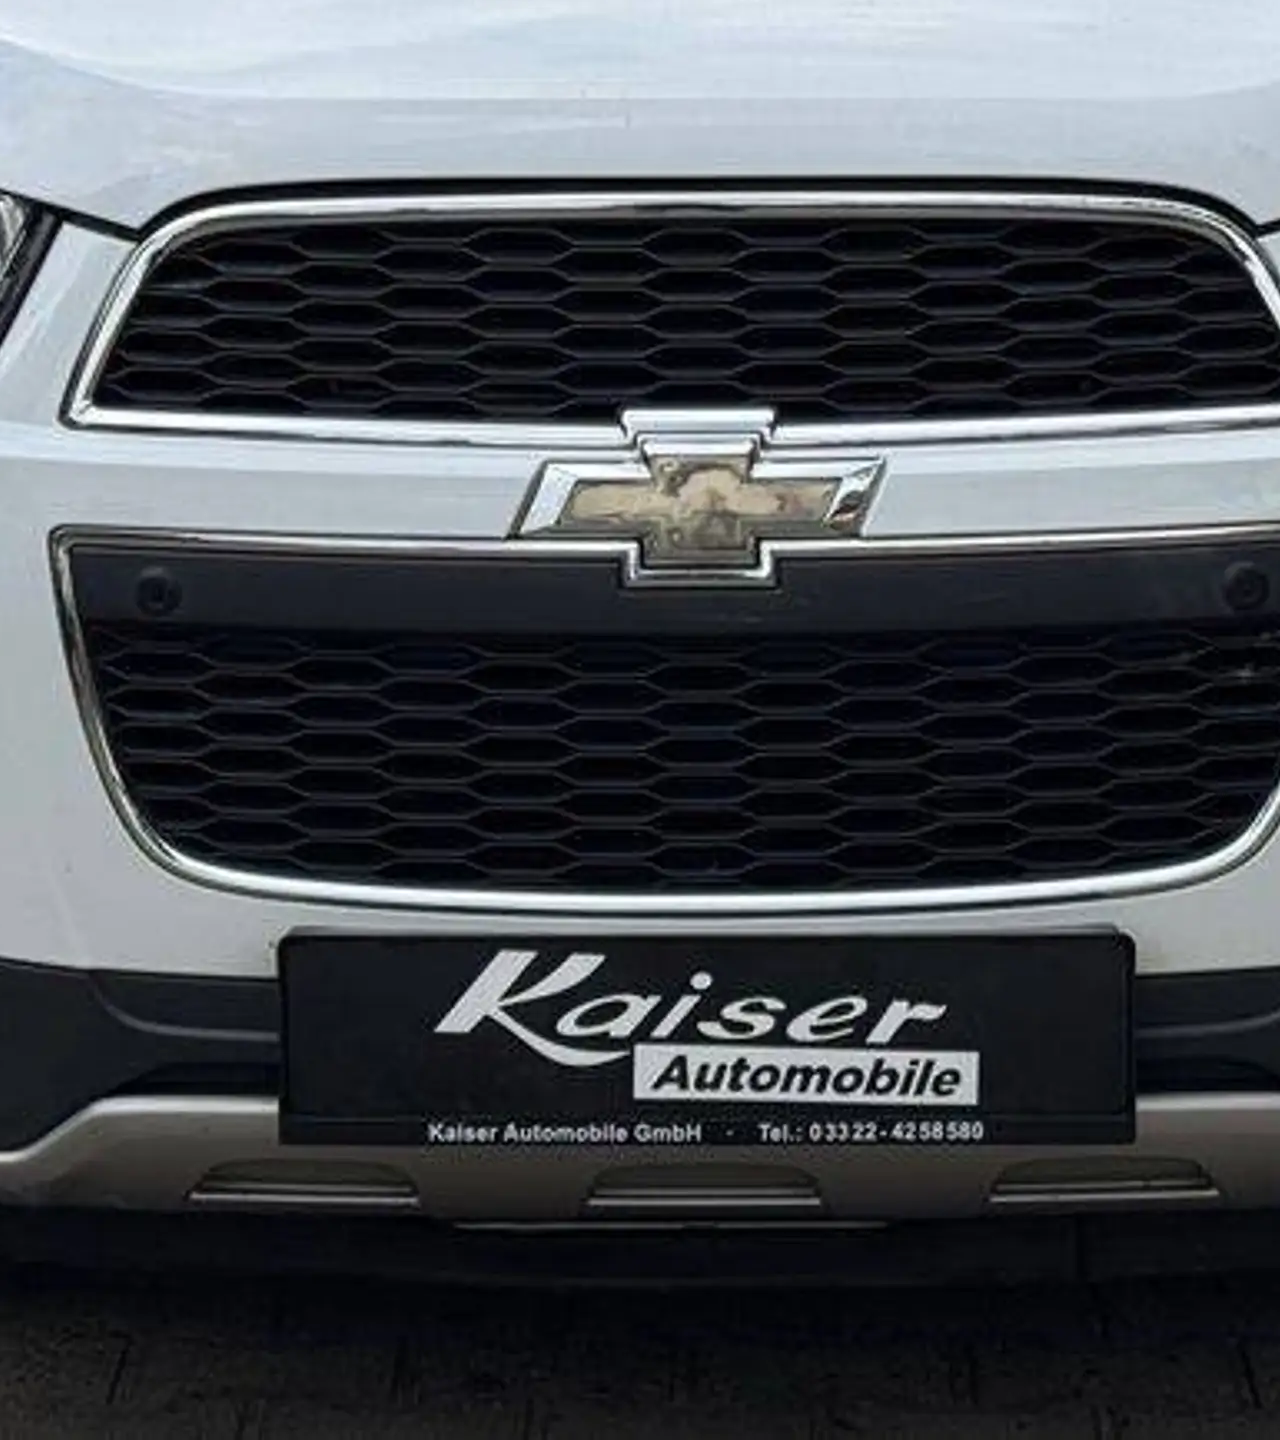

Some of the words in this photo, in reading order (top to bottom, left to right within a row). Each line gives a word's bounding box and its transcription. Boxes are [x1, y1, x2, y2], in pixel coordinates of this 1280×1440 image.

[432, 948, 947, 1066] Kaiser
[651, 1054, 961, 1097] Automobile
[428, 1123, 498, 1142] Kaiser
[503, 1123, 628, 1143] Automobile
[633, 1123, 703, 1142] GmbH
